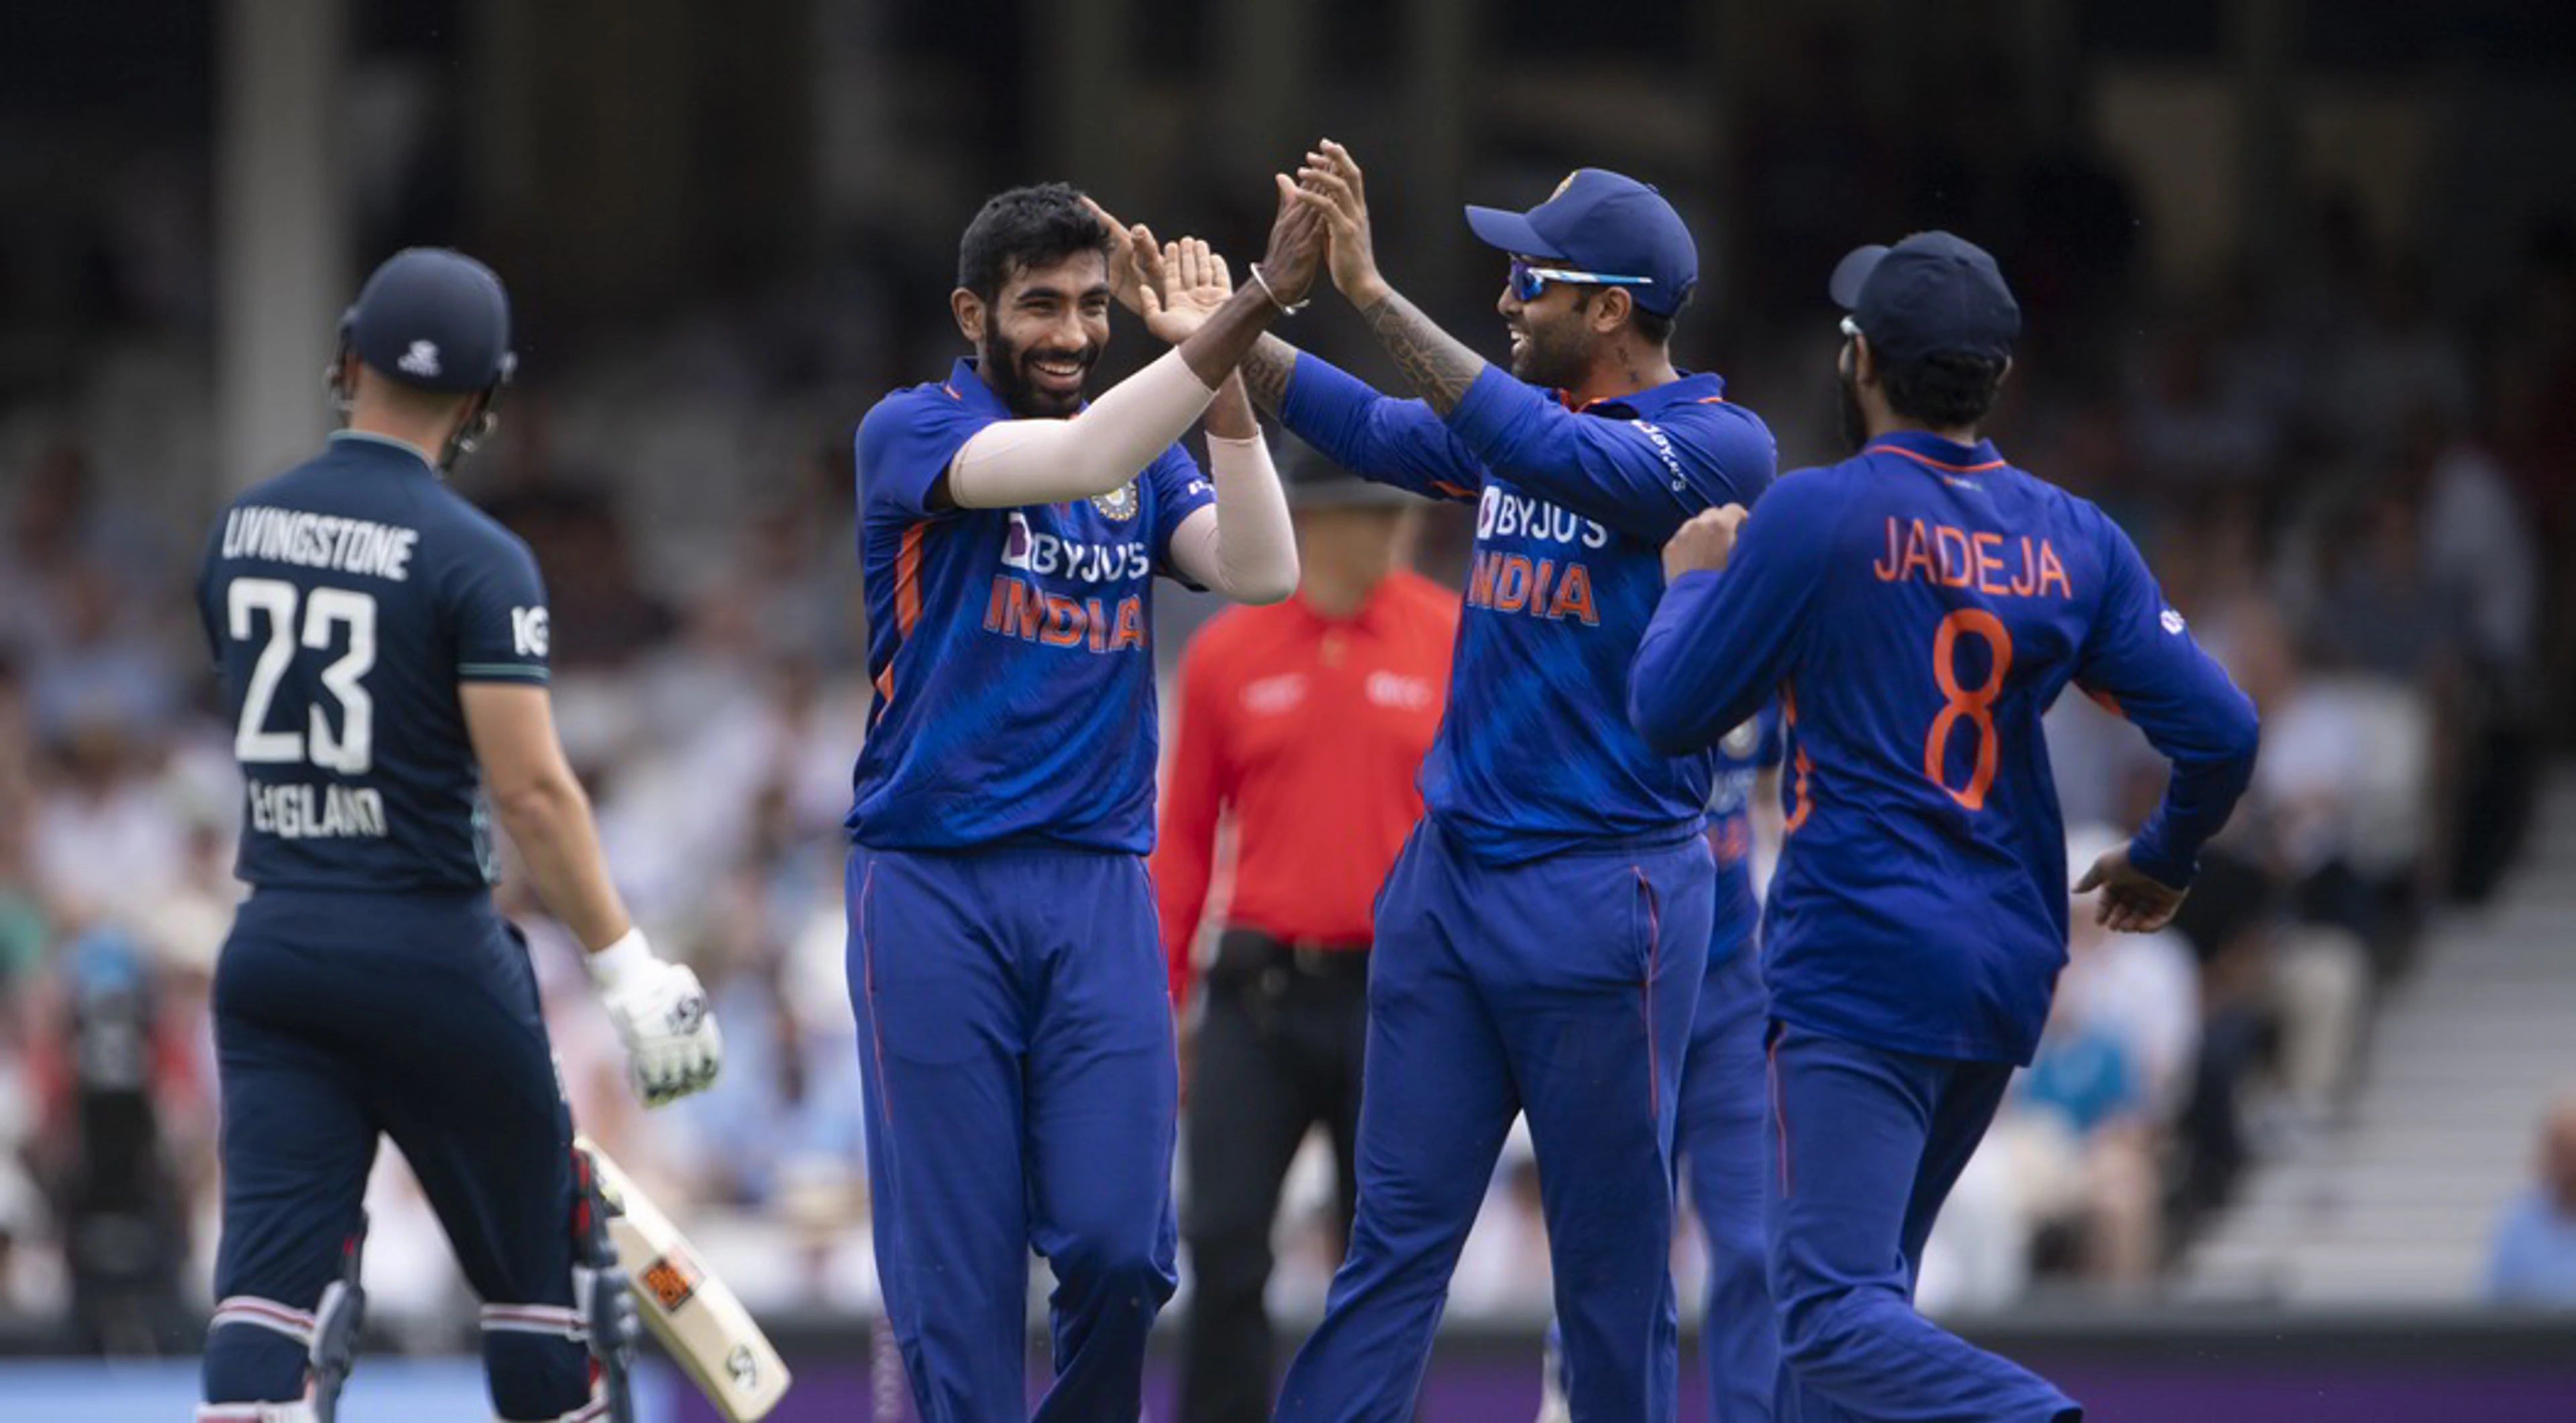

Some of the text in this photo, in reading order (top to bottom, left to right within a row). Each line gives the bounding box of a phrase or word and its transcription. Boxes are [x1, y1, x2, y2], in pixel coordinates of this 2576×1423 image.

[222, 506, 419, 582] LIVINGSTONE
[1874, 516, 2072, 599] JADEJA
[982, 574, 1148, 653] INDIA
[1467, 549, 1601, 627] NDIA
[227, 576, 377, 774] 23
[1924, 608, 2012, 810] 8
